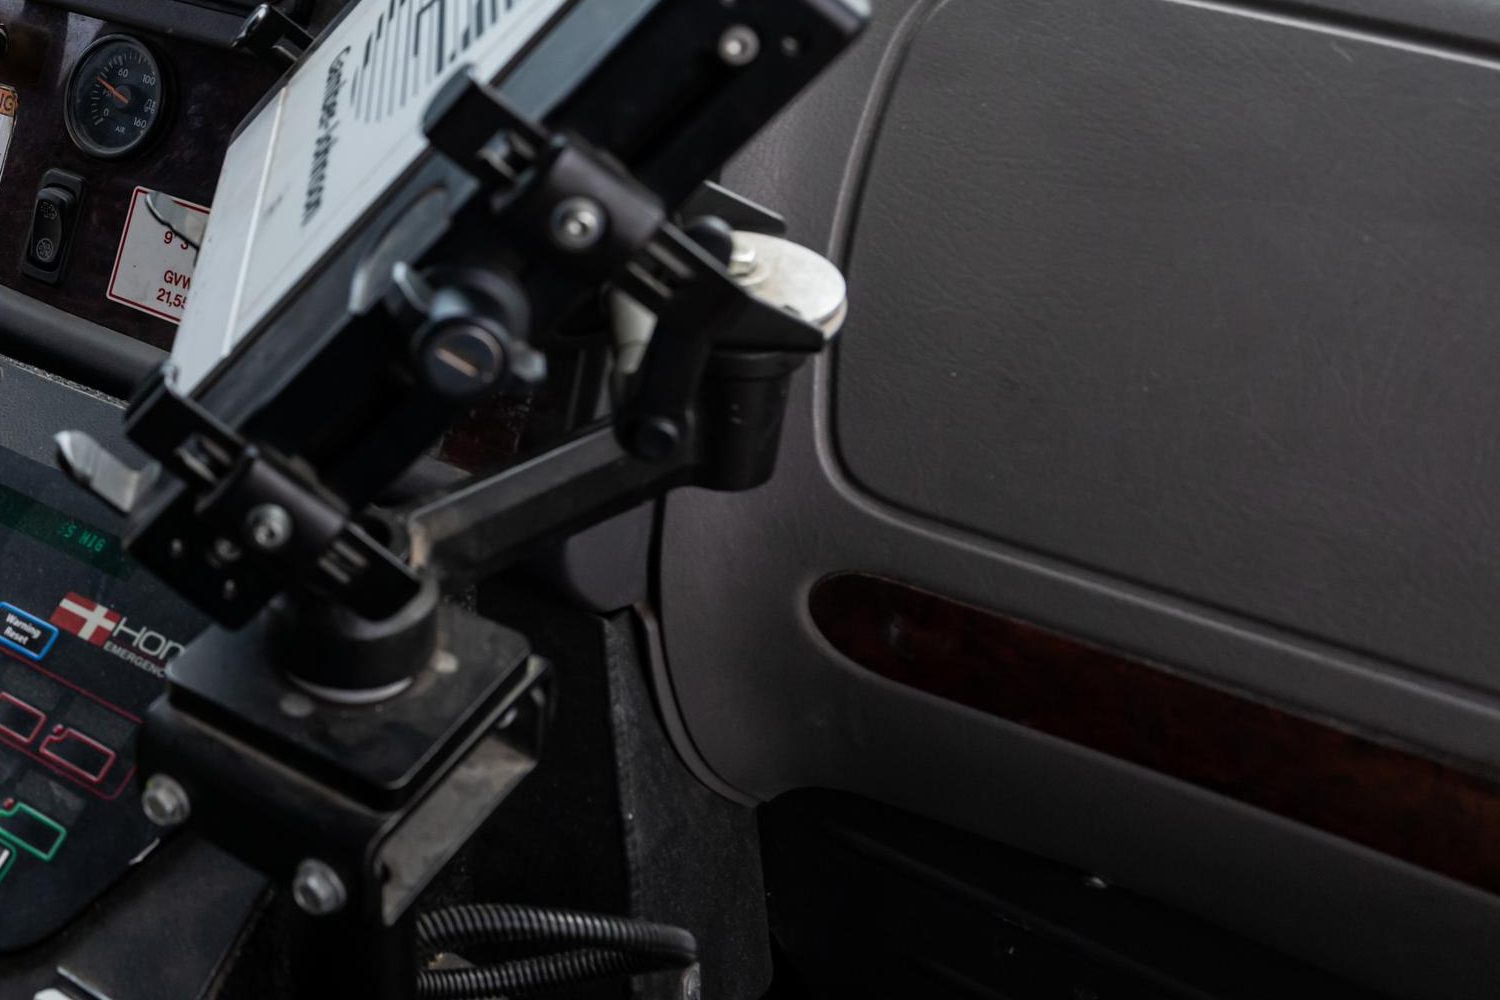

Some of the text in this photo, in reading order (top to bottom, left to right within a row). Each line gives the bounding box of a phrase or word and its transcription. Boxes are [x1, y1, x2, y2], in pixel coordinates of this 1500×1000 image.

[118, 68, 129, 78] 60
[142, 74, 156, 86] 100
[103, 108, 109, 117] 0
[133, 117, 147, 129] 160
[6, 613, 42, 639] Warning
[4, 625, 29, 646] Reset
